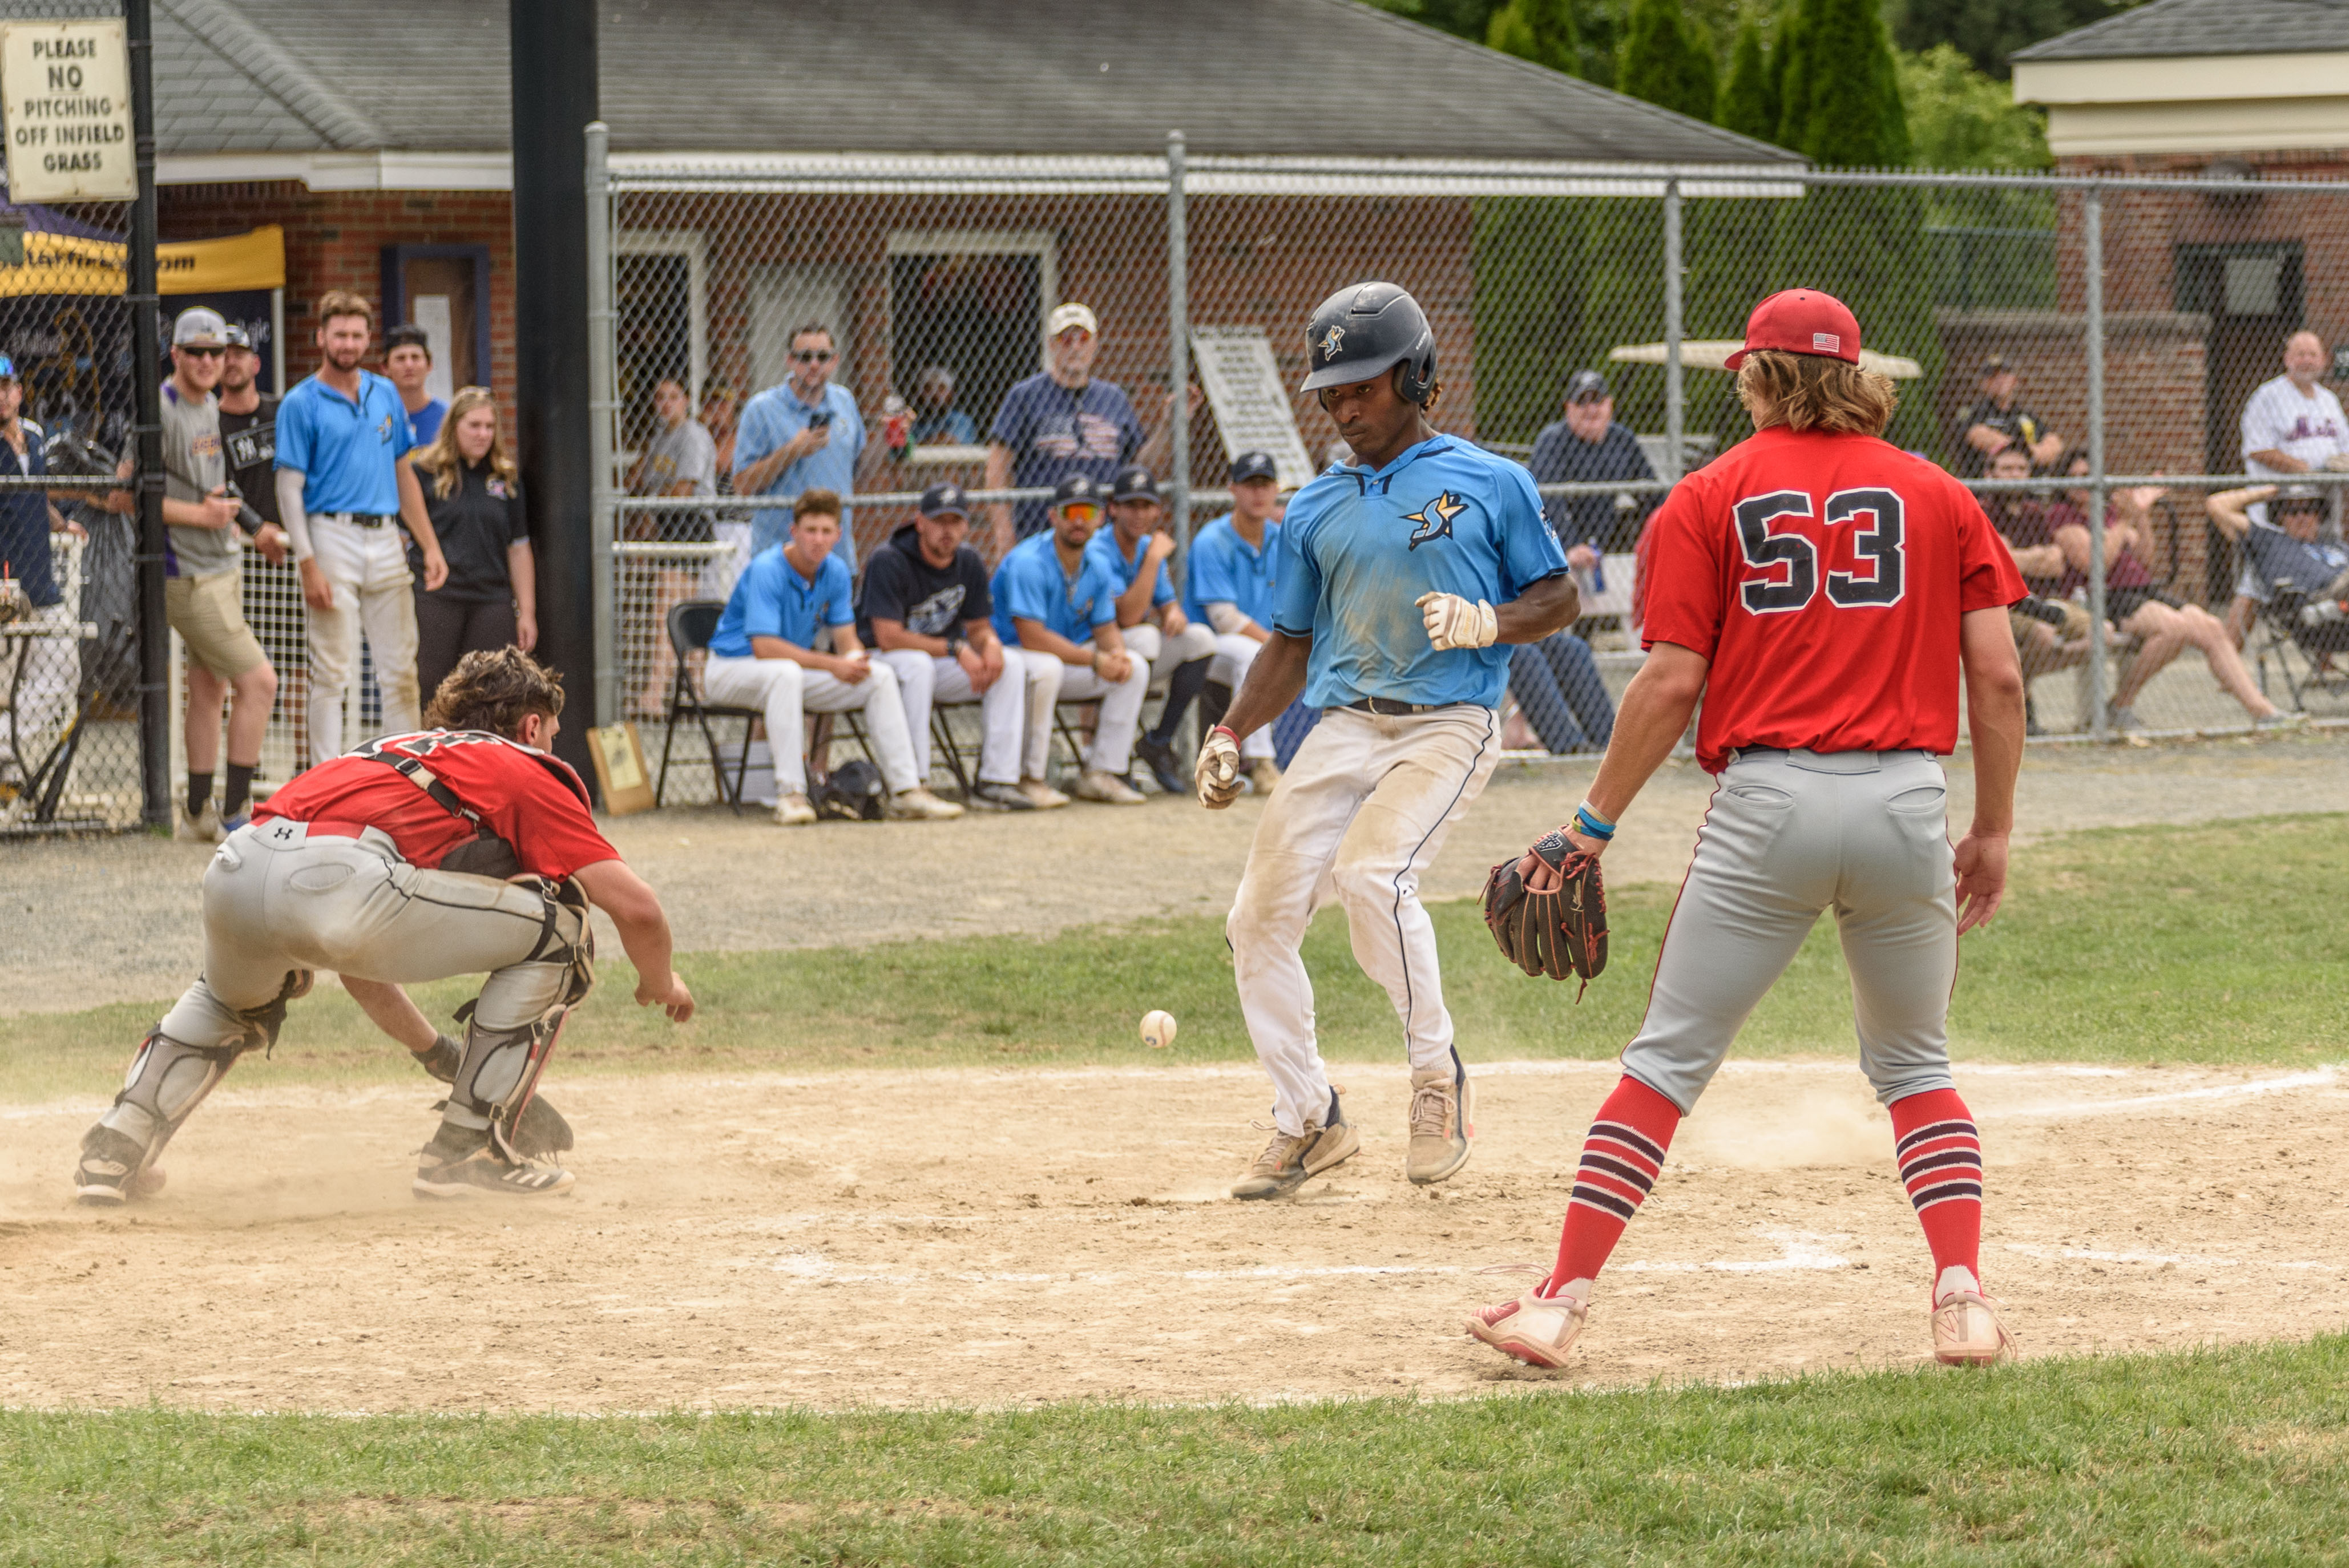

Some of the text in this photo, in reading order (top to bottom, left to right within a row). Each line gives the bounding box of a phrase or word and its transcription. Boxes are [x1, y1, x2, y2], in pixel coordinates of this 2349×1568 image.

[33, 38, 96, 59] PLEASE
[48, 64, 83, 90] NO
[25, 97, 112, 118] PITCHING
[15, 124, 125, 147] OFF INFIELD
[43, 151, 102, 173] GRASS
[1732, 487, 1906, 616] 53
